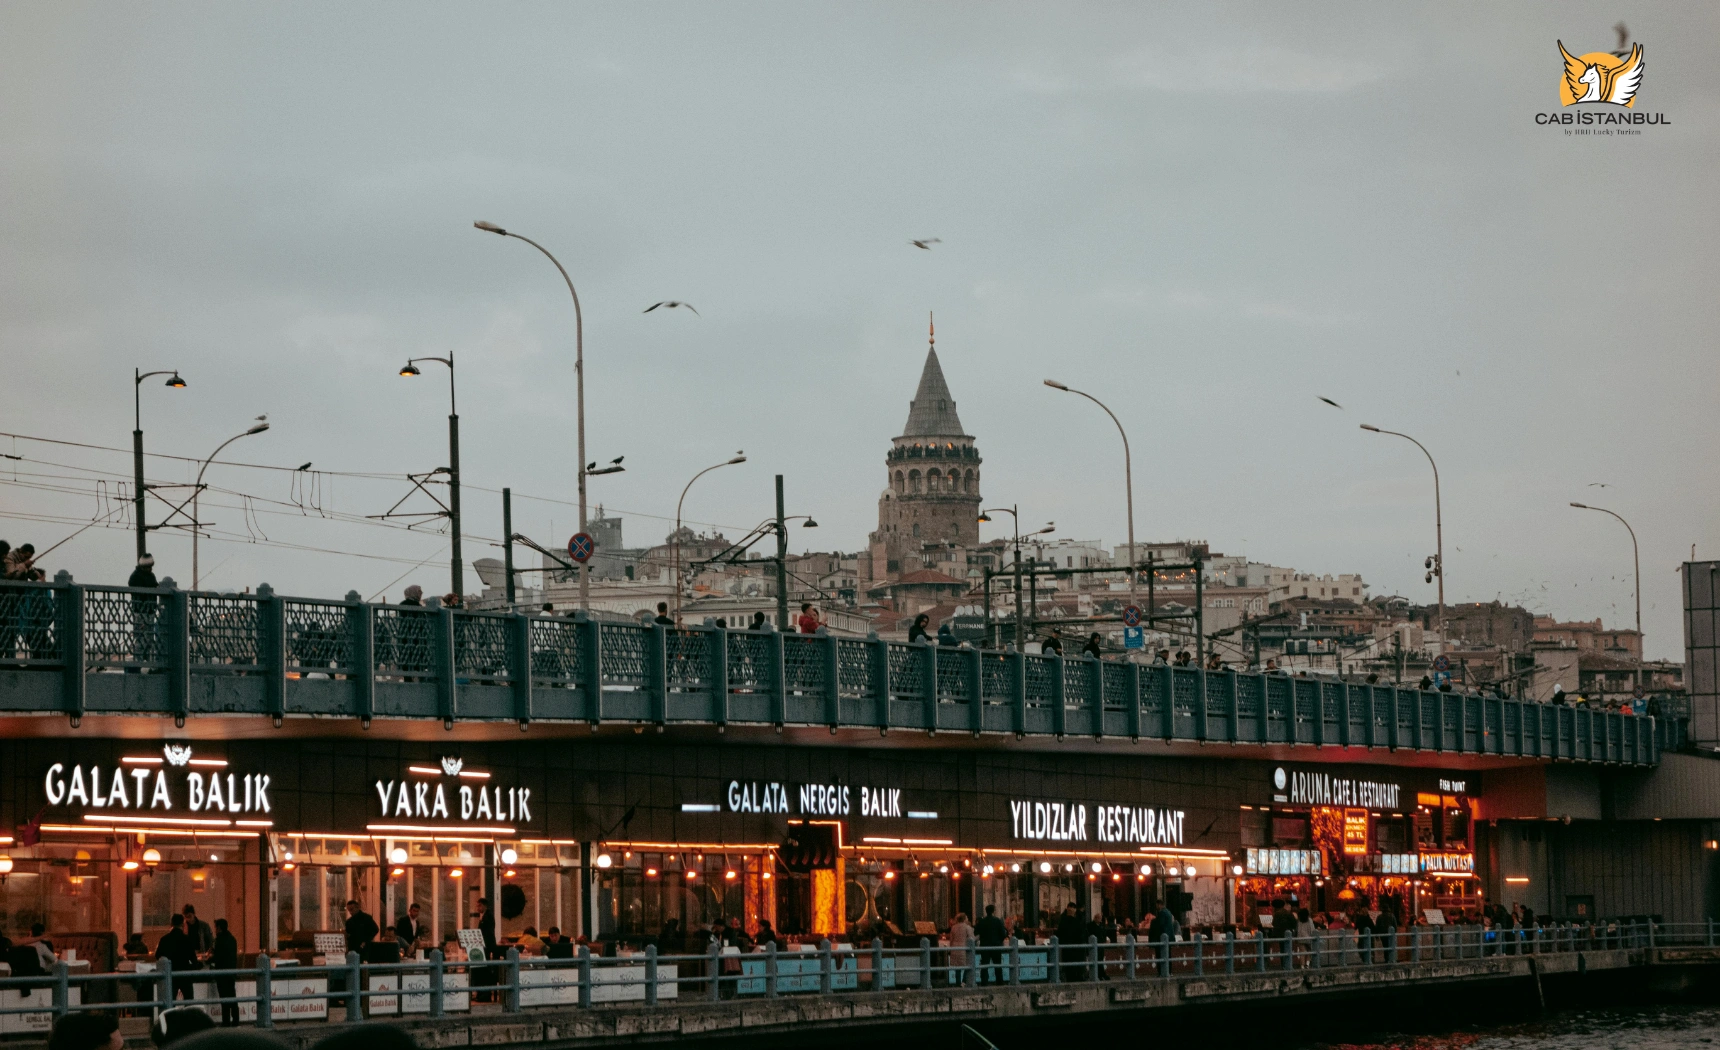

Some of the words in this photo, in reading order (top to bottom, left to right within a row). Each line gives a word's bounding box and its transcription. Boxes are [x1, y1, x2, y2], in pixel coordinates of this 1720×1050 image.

[45, 763, 172, 810] GALATA
[187, 771, 272, 813] BALIK
[375, 779, 448, 819] YAKA
[459, 785, 532, 822] BALIK
[728, 780, 789, 813] GALATA
[800, 783, 850, 816] NERGIS
[861, 786, 902, 818] BALIK
[1291, 770, 1331, 805] ARUNA
[1333, 777, 1351, 806] CAFE
[1359, 780, 1401, 809] RESTAURANT
[1439, 778, 1451, 792] FISH
[1451, 780, 1466, 792] POINT
[1010, 800, 1088, 842] YILDIZLAR
[1098, 805, 1185, 845] RESTAURANT
[1356, 831, 1364, 839] TL
[291, 1004, 308, 1013] Galata
